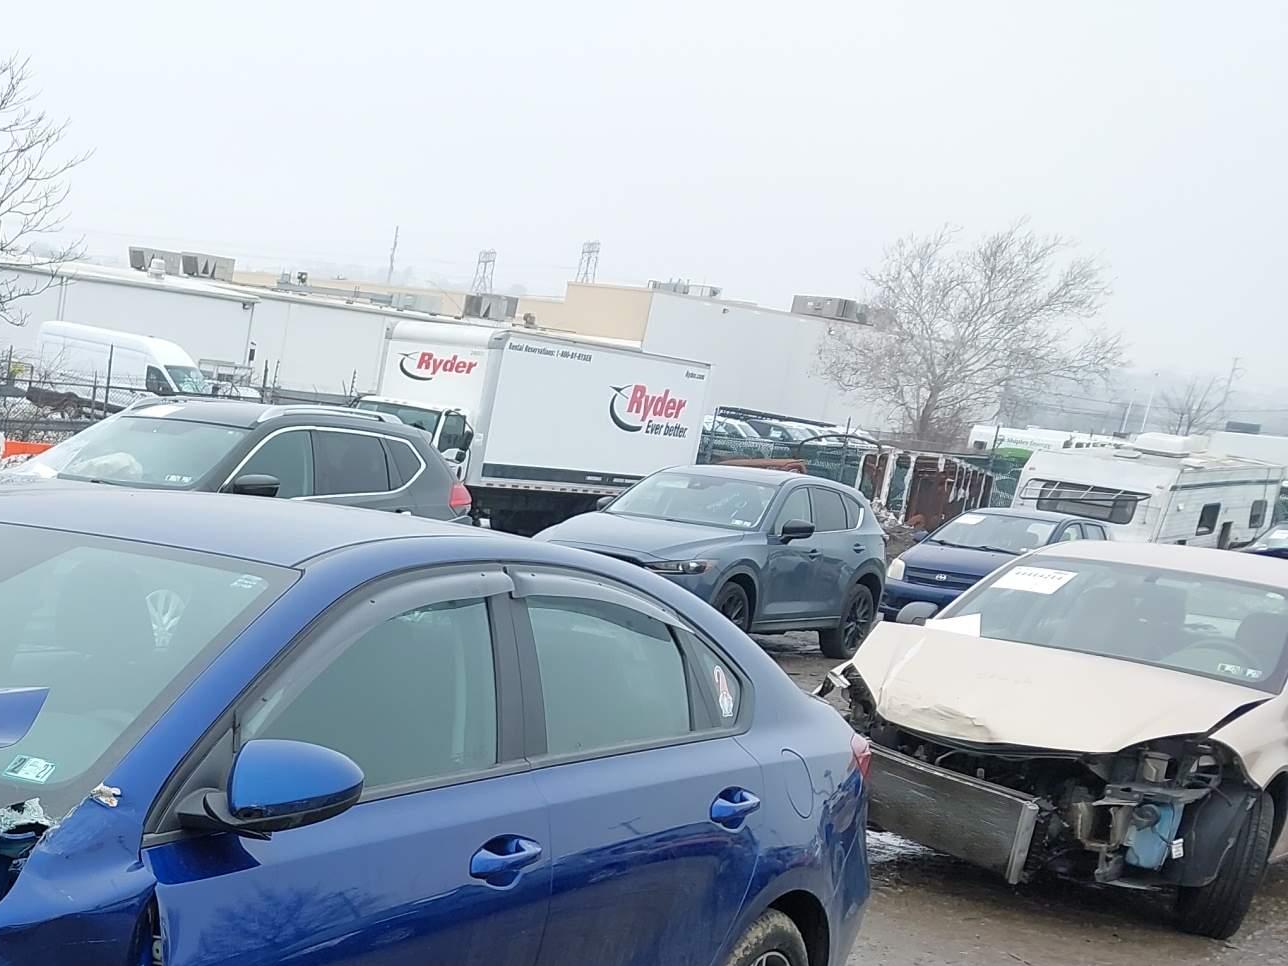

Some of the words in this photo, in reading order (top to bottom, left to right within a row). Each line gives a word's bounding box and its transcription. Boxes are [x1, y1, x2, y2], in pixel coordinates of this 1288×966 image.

[416, 352, 478, 375] Ryder
[626, 384, 688, 422] Ryder
[645, 420, 663, 434] Ever
[663, 422, 688, 438] better.
